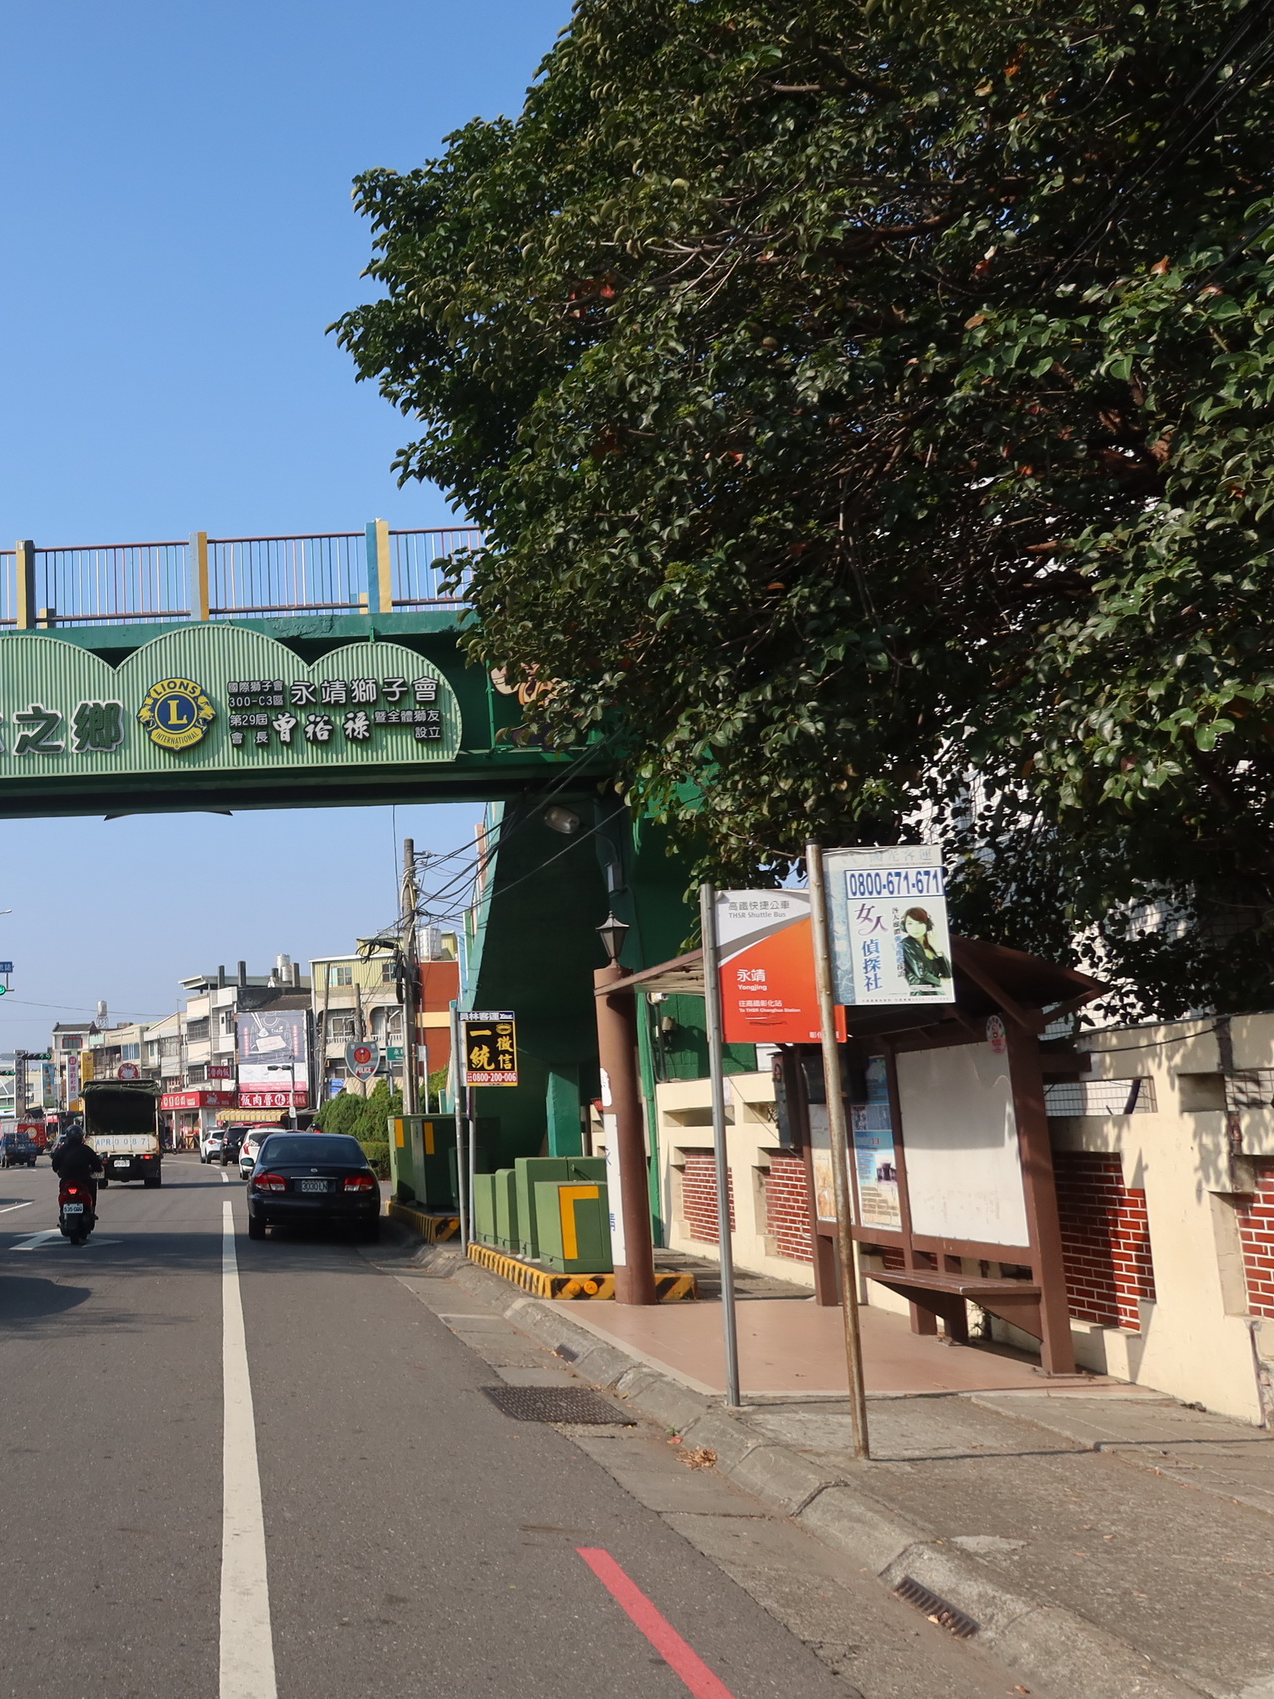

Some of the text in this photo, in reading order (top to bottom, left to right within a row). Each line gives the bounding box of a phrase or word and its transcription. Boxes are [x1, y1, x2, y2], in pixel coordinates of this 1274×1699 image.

[153, 680, 198, 696] LIONS
[228, 680, 284, 693] 國際獅子會
[291, 677, 438, 705] 永靖獅子會
[229, 695, 284, 707] 300-C3區
[167, 700, 188, 725] L
[375, 710, 440, 723] 暨全體獅友
[230, 714, 268, 727] 第29屆
[155, 732, 199, 745] INTERNATIONAL
[415, 726, 441, 739] 設立
[849, 870, 939, 896] 0800-671-671
[728, 901, 790, 911] 高鐵快捷公車
[854, 903, 888, 992] 女人 偵探社
[737, 969, 766, 982] 永靖
